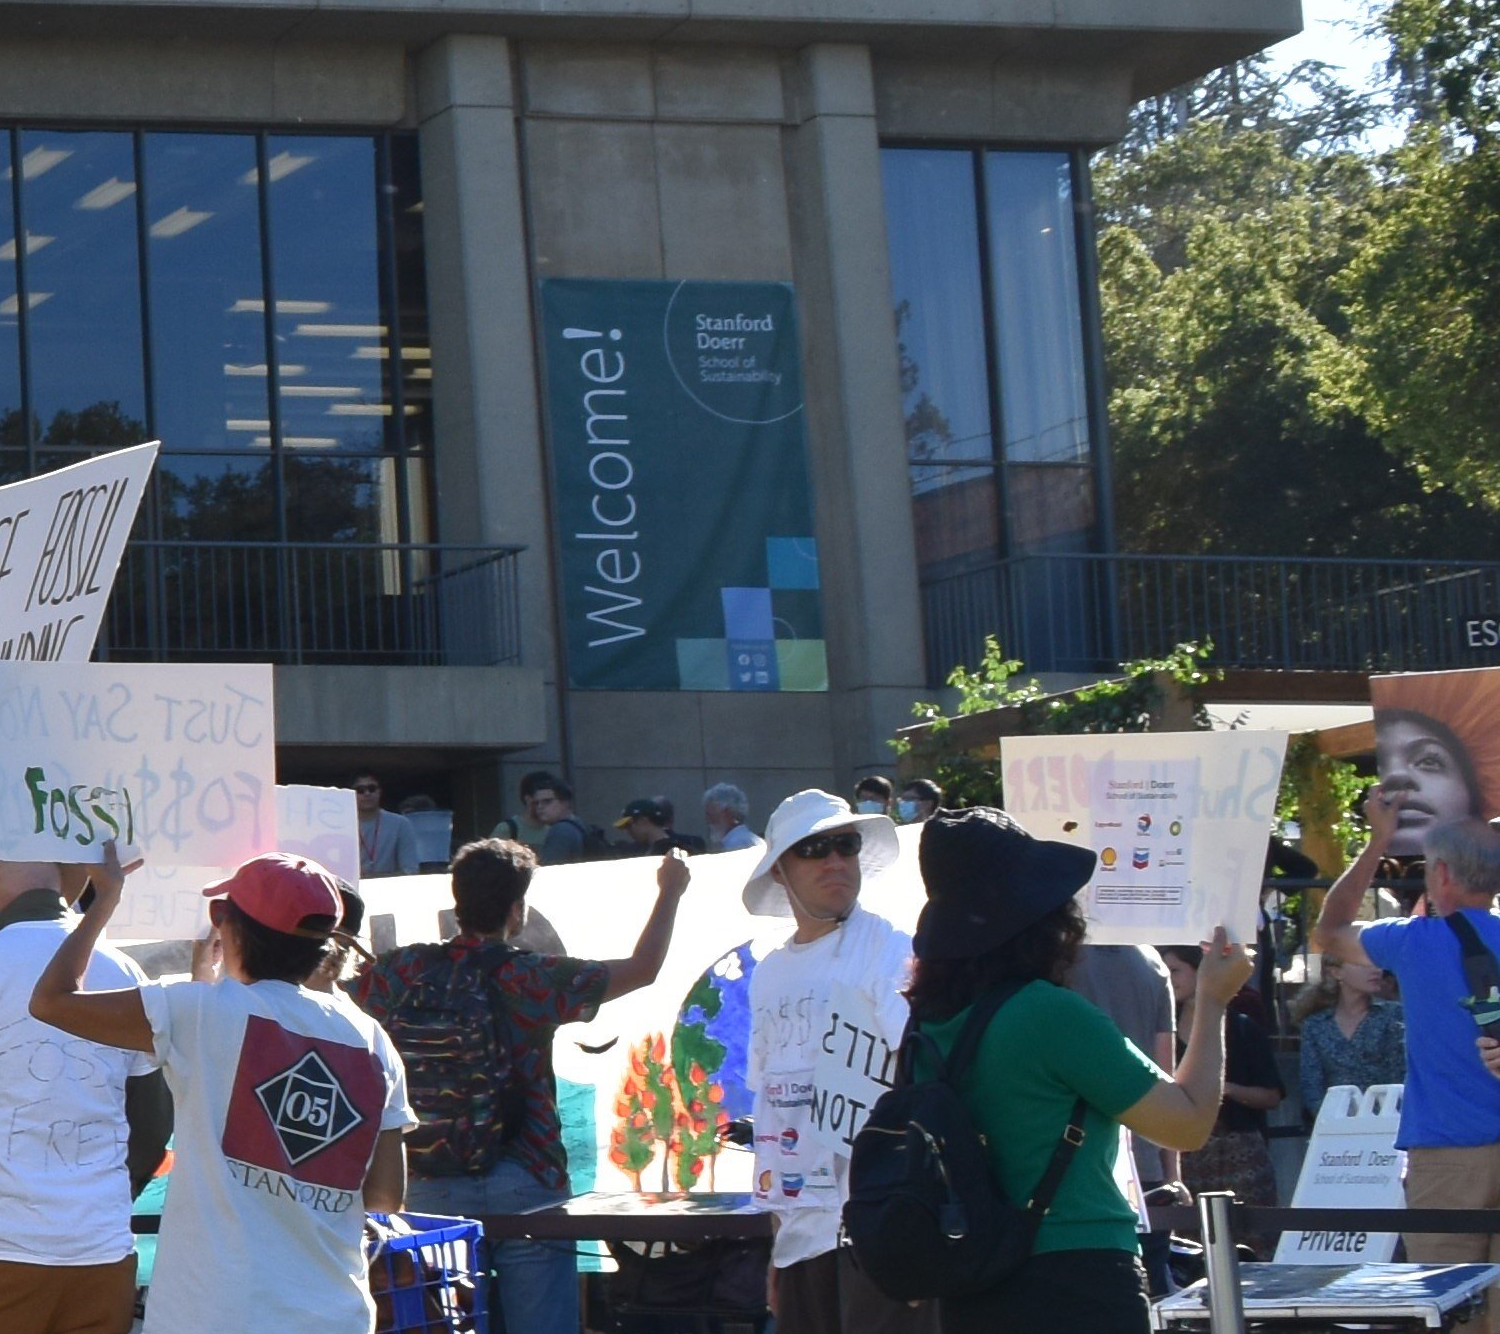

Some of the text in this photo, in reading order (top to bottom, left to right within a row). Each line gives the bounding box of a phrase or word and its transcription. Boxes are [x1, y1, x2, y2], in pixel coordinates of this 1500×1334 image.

[695, 313, 774, 331] Stanford
[696, 332, 747, 349] Doerr
[699, 355, 757, 368] School of
[562, 326, 646, 648] Welcome!
[24, 477, 129, 613] FOSSIL
[1466, 619, 1500, 646] ES
[285, 1090, 329, 1127] 05
[1318, 1150, 1398, 1167] Stanford Doerr
[227, 1159, 355, 1213] STANORD
[1297, 1231, 1368, 1252] Private
